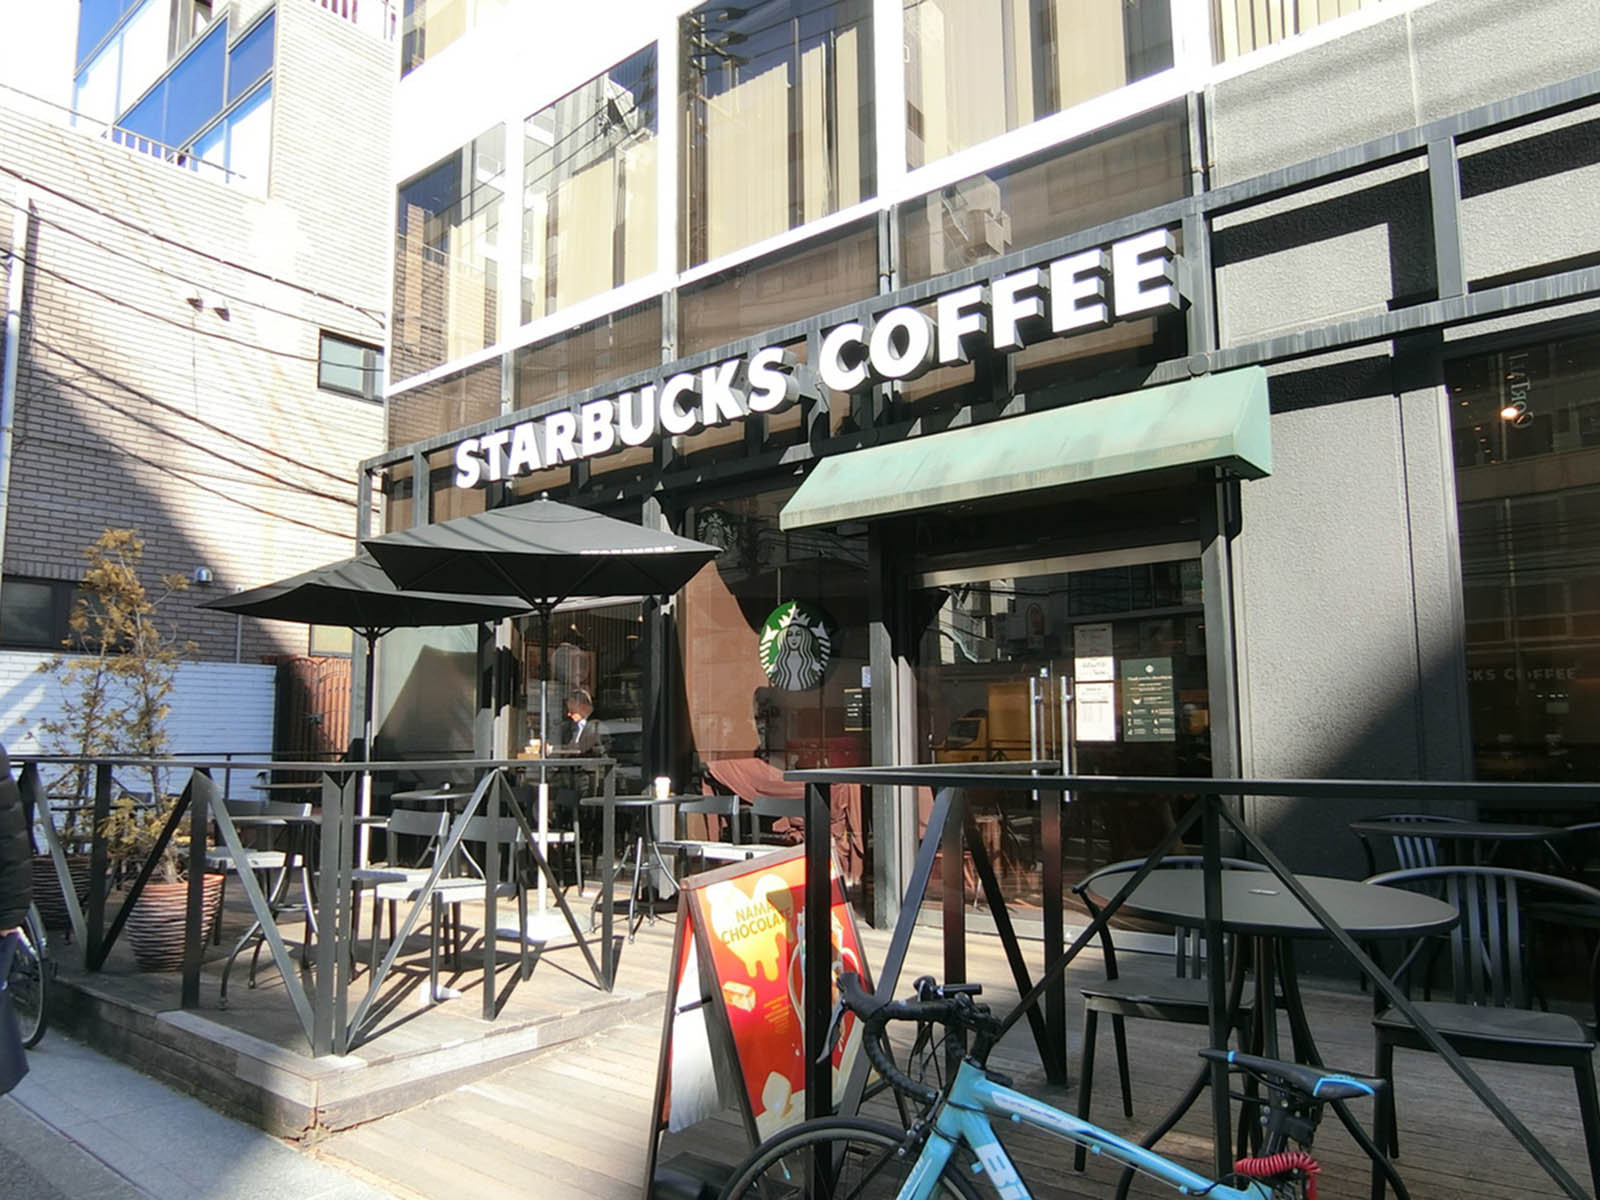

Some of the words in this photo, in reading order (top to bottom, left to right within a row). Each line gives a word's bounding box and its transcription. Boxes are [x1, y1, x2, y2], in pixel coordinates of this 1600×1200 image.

[455, 346, 792, 489] STARBUCKS
[819, 228, 1176, 392] COFFEE
[721, 907, 794, 945] CHOCOLA
